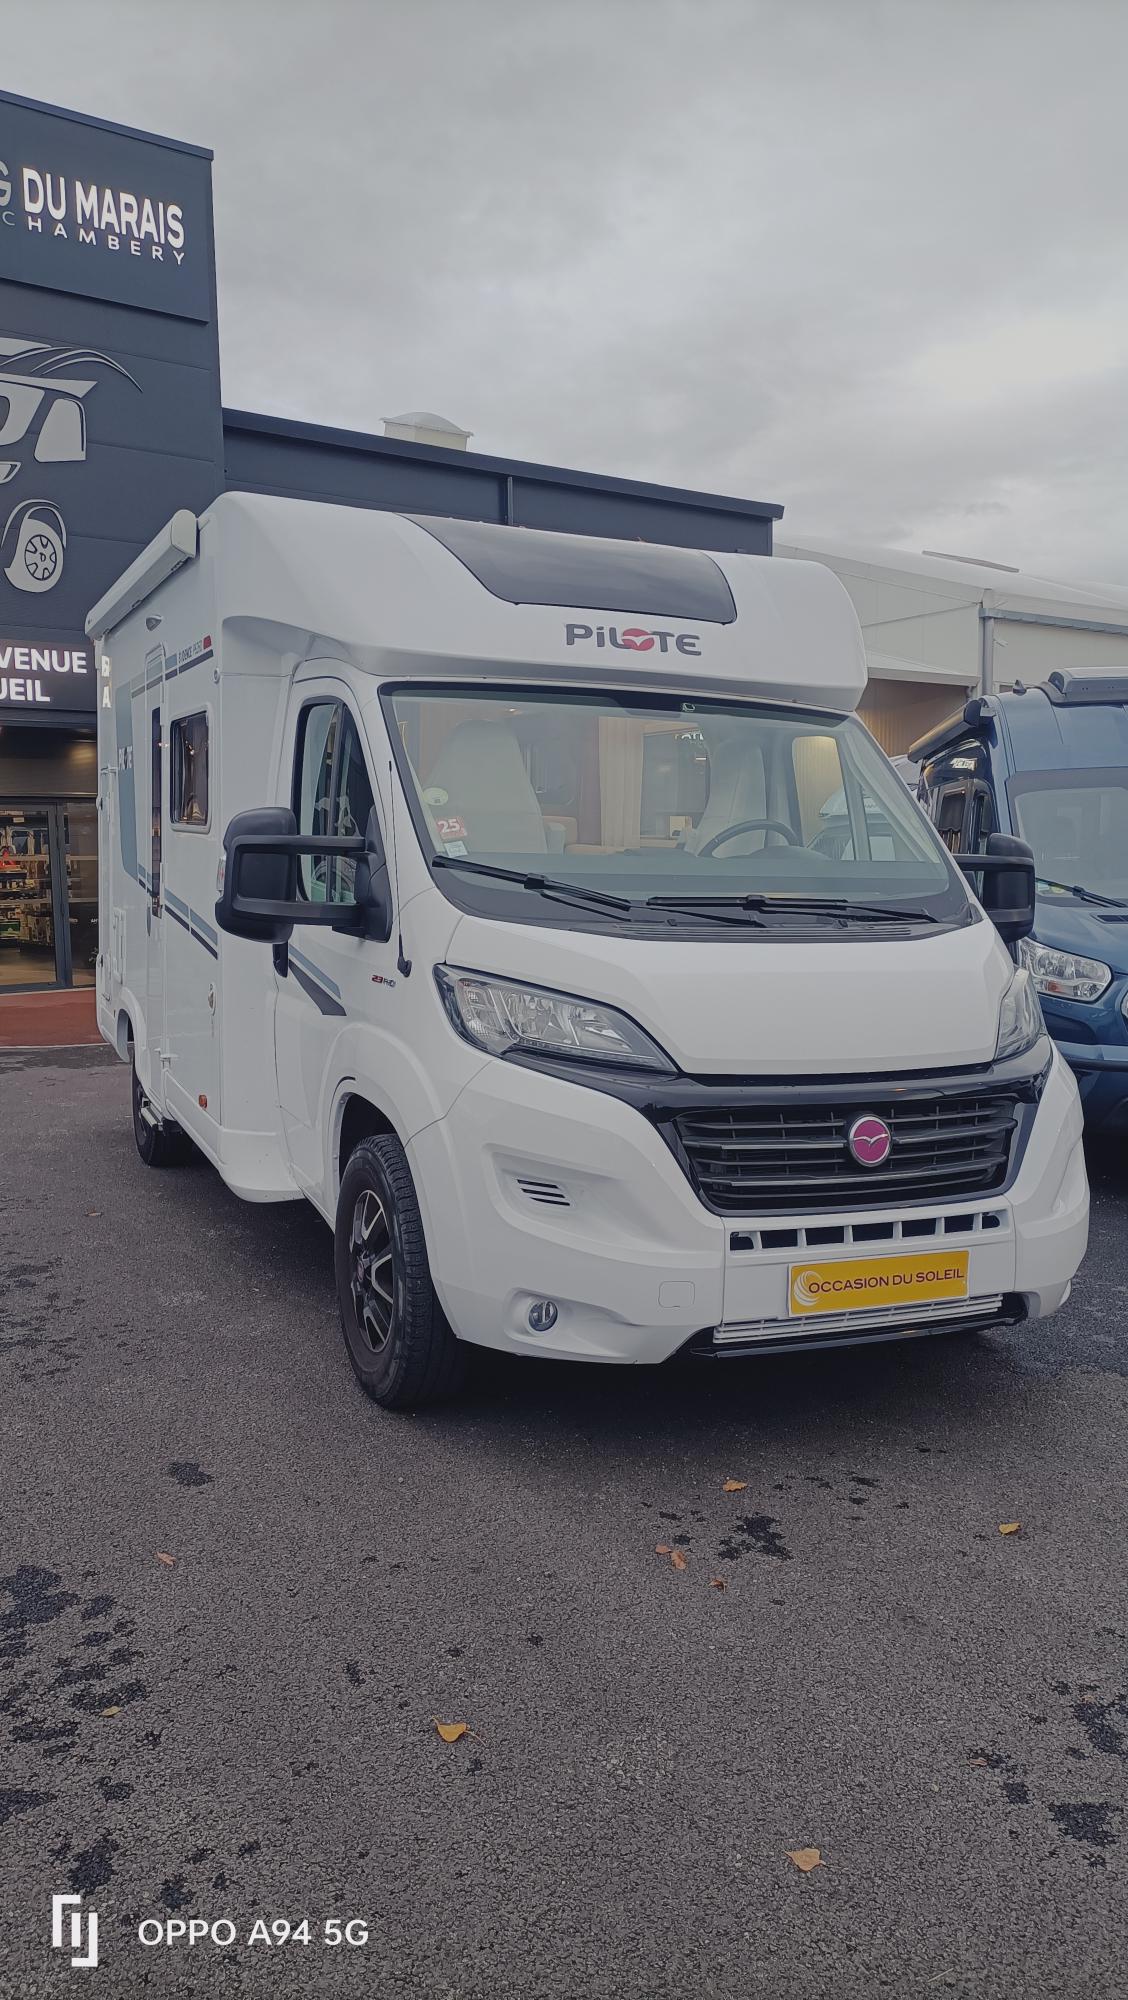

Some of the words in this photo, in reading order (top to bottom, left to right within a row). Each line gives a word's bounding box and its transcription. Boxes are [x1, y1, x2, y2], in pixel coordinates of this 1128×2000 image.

[22, 167, 67, 220] DU
[75, 180, 185, 249] MARAIS
[2, 210, 185, 266] CHAMBERY
[808, 1275, 889, 1294] OCCASION
[892, 1273, 913, 1286] DU
[915, 1268, 965, 1283] SOLEIL
